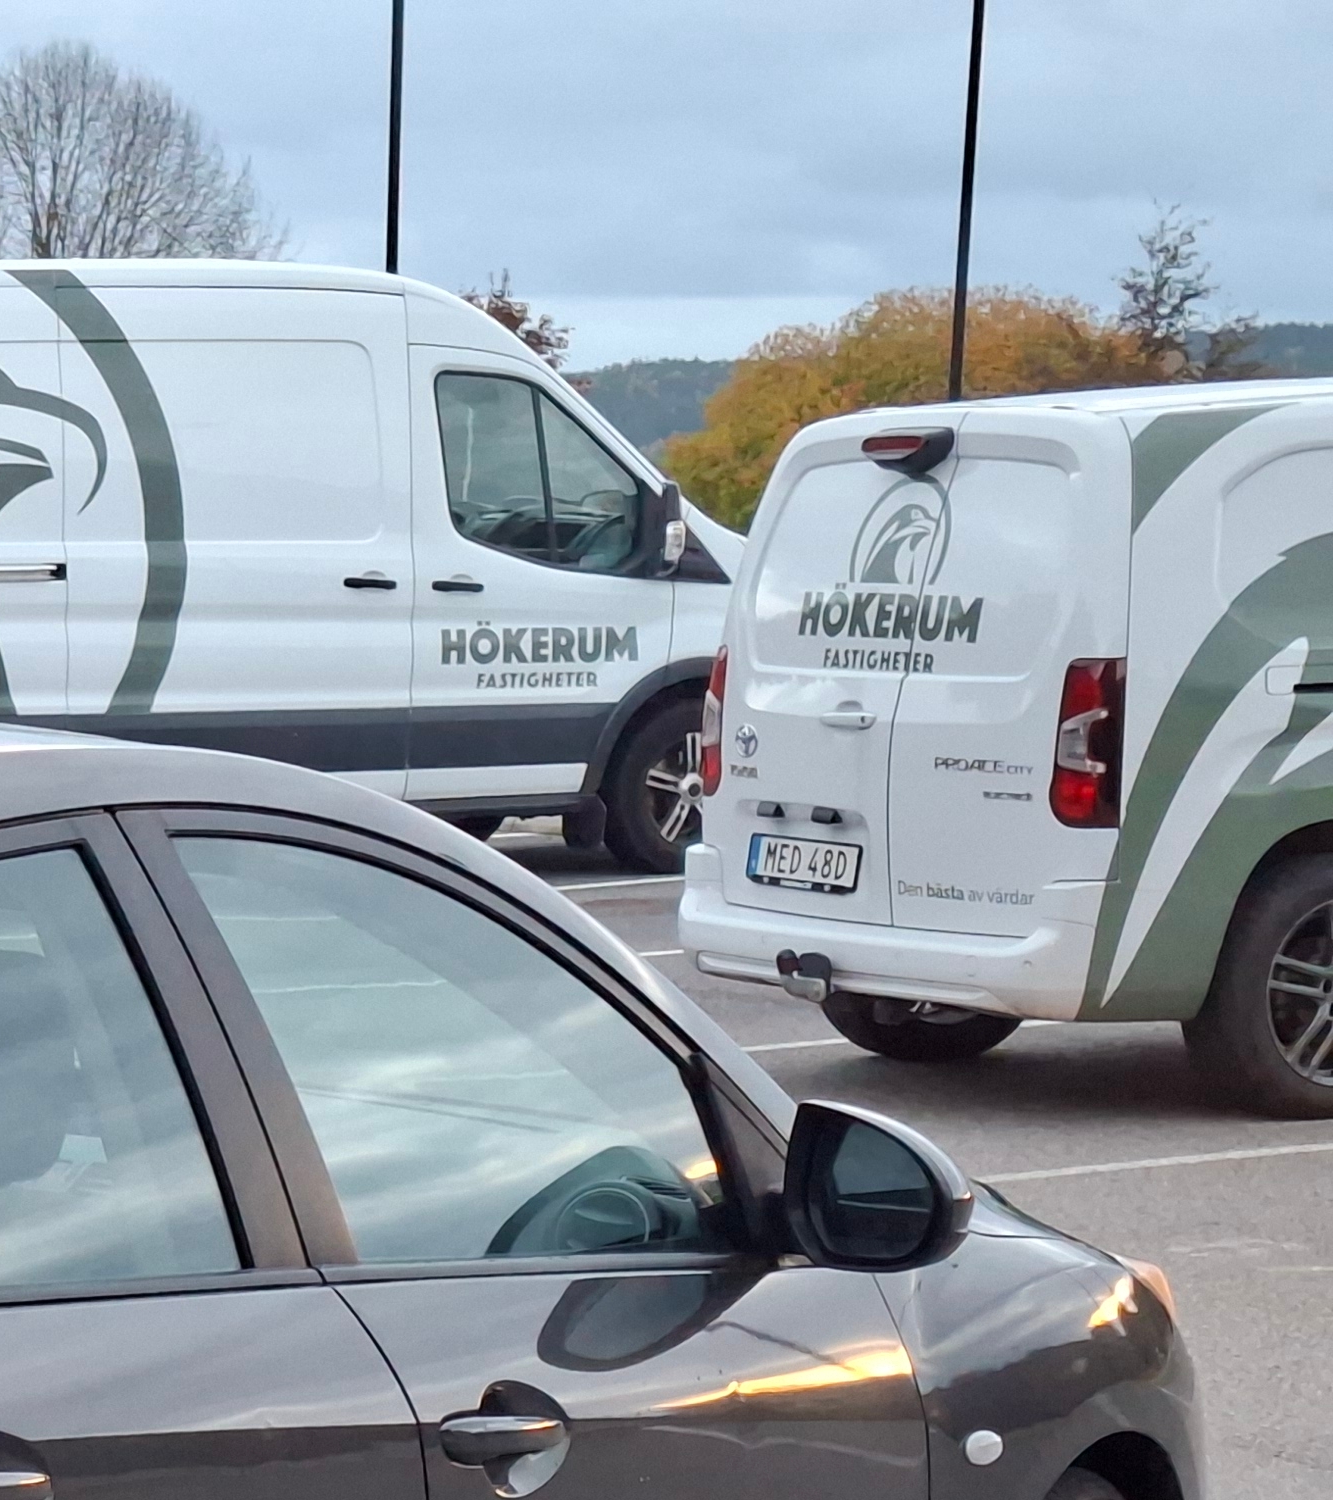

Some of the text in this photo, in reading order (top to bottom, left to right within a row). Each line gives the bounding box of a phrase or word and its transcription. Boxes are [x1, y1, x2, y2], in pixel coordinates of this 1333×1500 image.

[798, 582, 984, 643] HÖKERUM
[440, 620, 639, 666] HÖKERUM
[822, 647, 935, 674] FASTIGHETER
[475, 671, 599, 690] FASTIGHETER
[764, 841, 848, 881] MED 48D
[897, 879, 924, 897] Den
[967, 889, 984, 902] av
